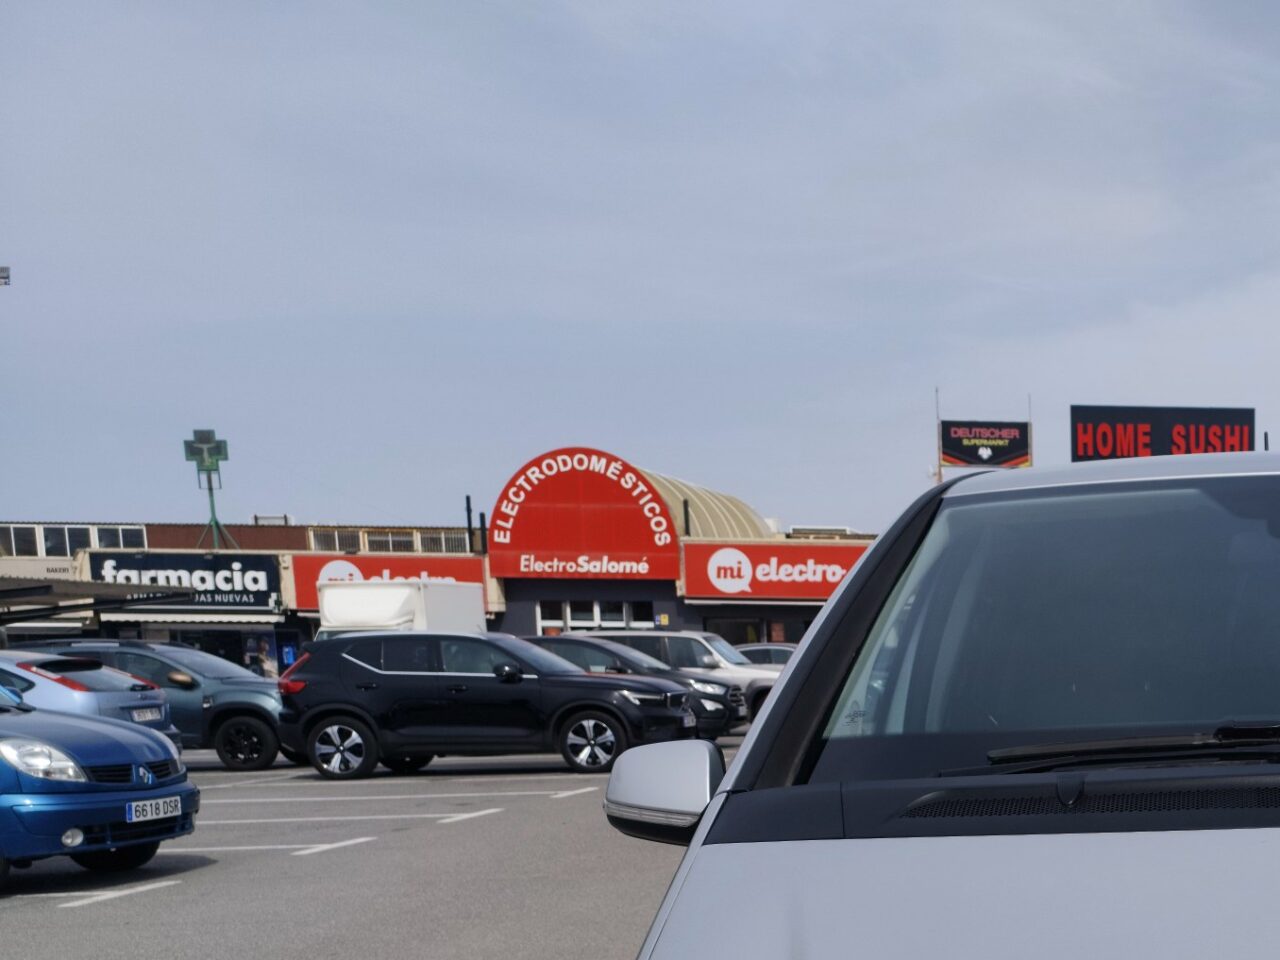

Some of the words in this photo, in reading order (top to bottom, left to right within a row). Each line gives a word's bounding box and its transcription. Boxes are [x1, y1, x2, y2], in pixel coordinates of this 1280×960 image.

[950, 427, 1020, 439] DEUTSCHER
[1077, 423, 1151, 457] HOME
[1171, 424, 1249, 455] SUSHI
[493, 453, 671, 546] ELECTRODOMÉSTICOS
[101, 559, 268, 592] farmacia
[520, 554, 649, 574] ElectroSalomé
[716, 561, 744, 580] mi
[755, 557, 847, 584] electro
[215, 594, 255, 604] NUEVAS
[134, 801, 160, 818] 6618
